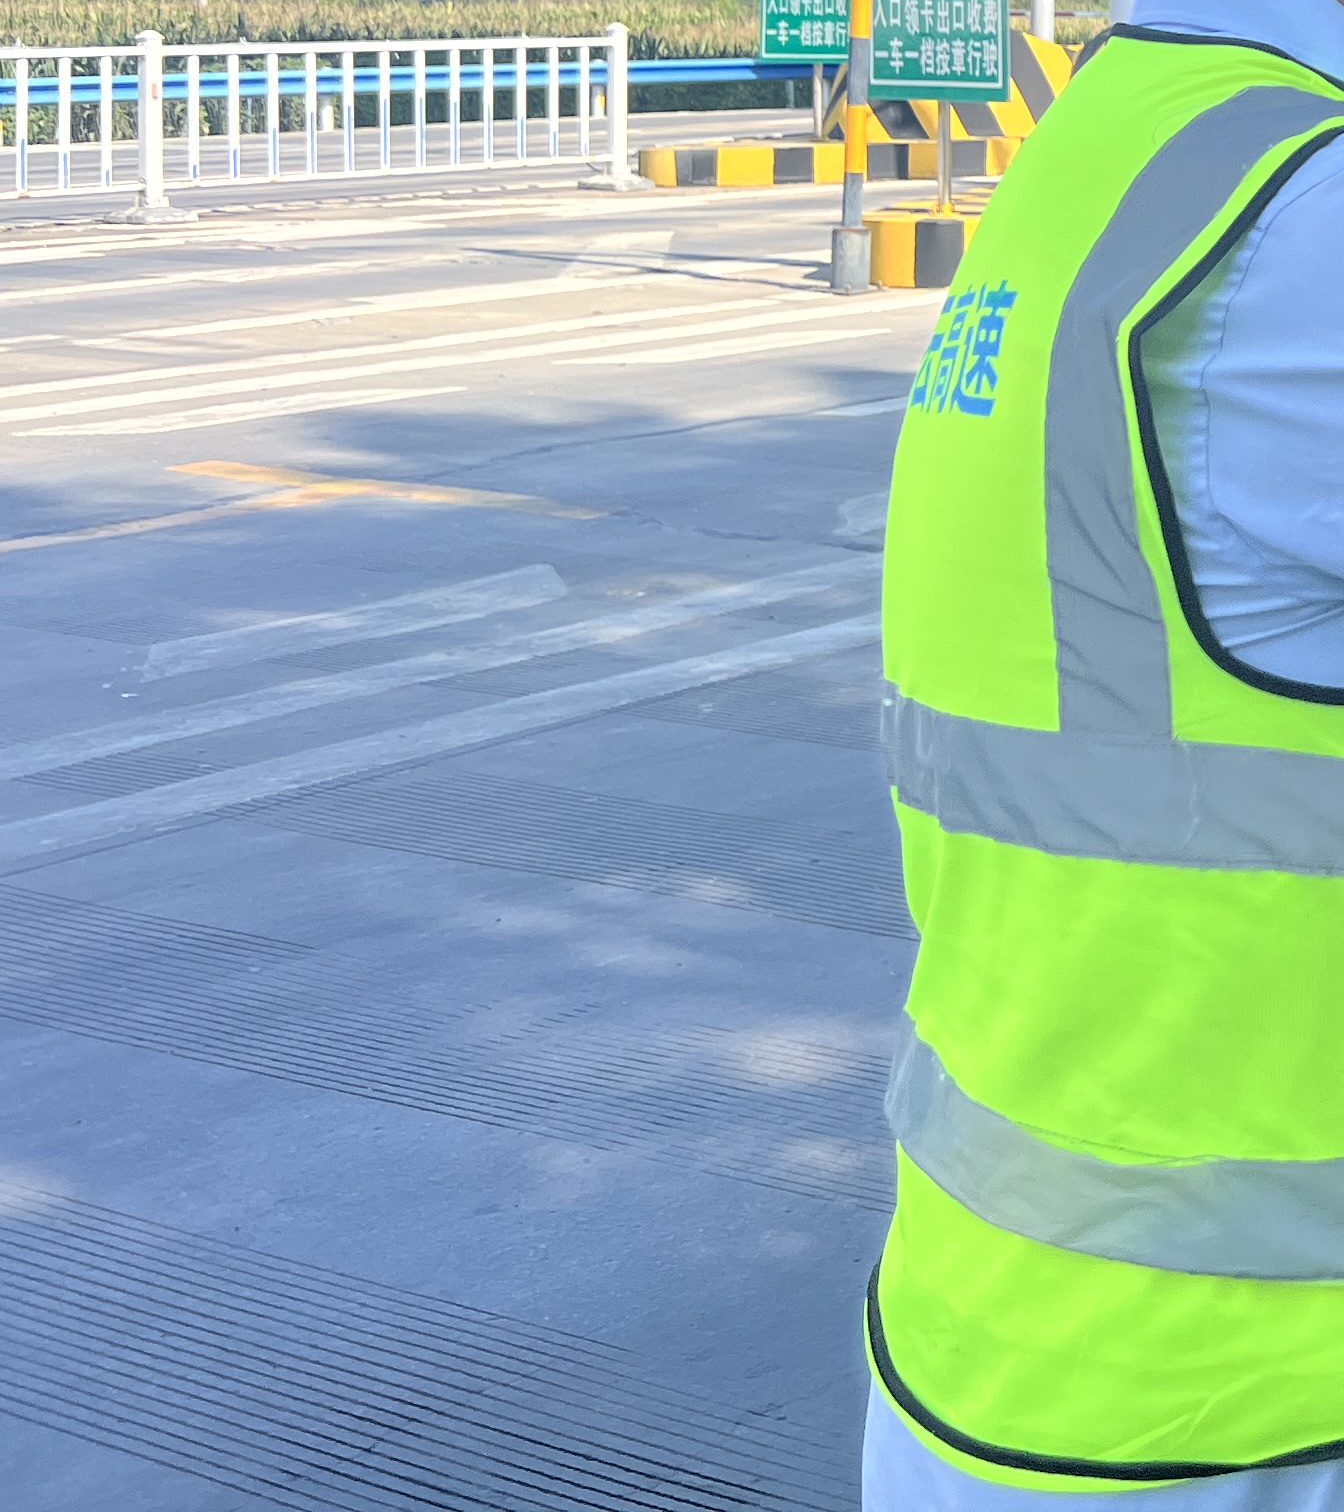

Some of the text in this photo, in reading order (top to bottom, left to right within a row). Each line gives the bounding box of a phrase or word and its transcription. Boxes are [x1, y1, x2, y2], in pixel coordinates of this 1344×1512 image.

[766, 19, 849, 48] 一车一档按章行
[874, 37, 998, 77] 一车一档按章行驶
